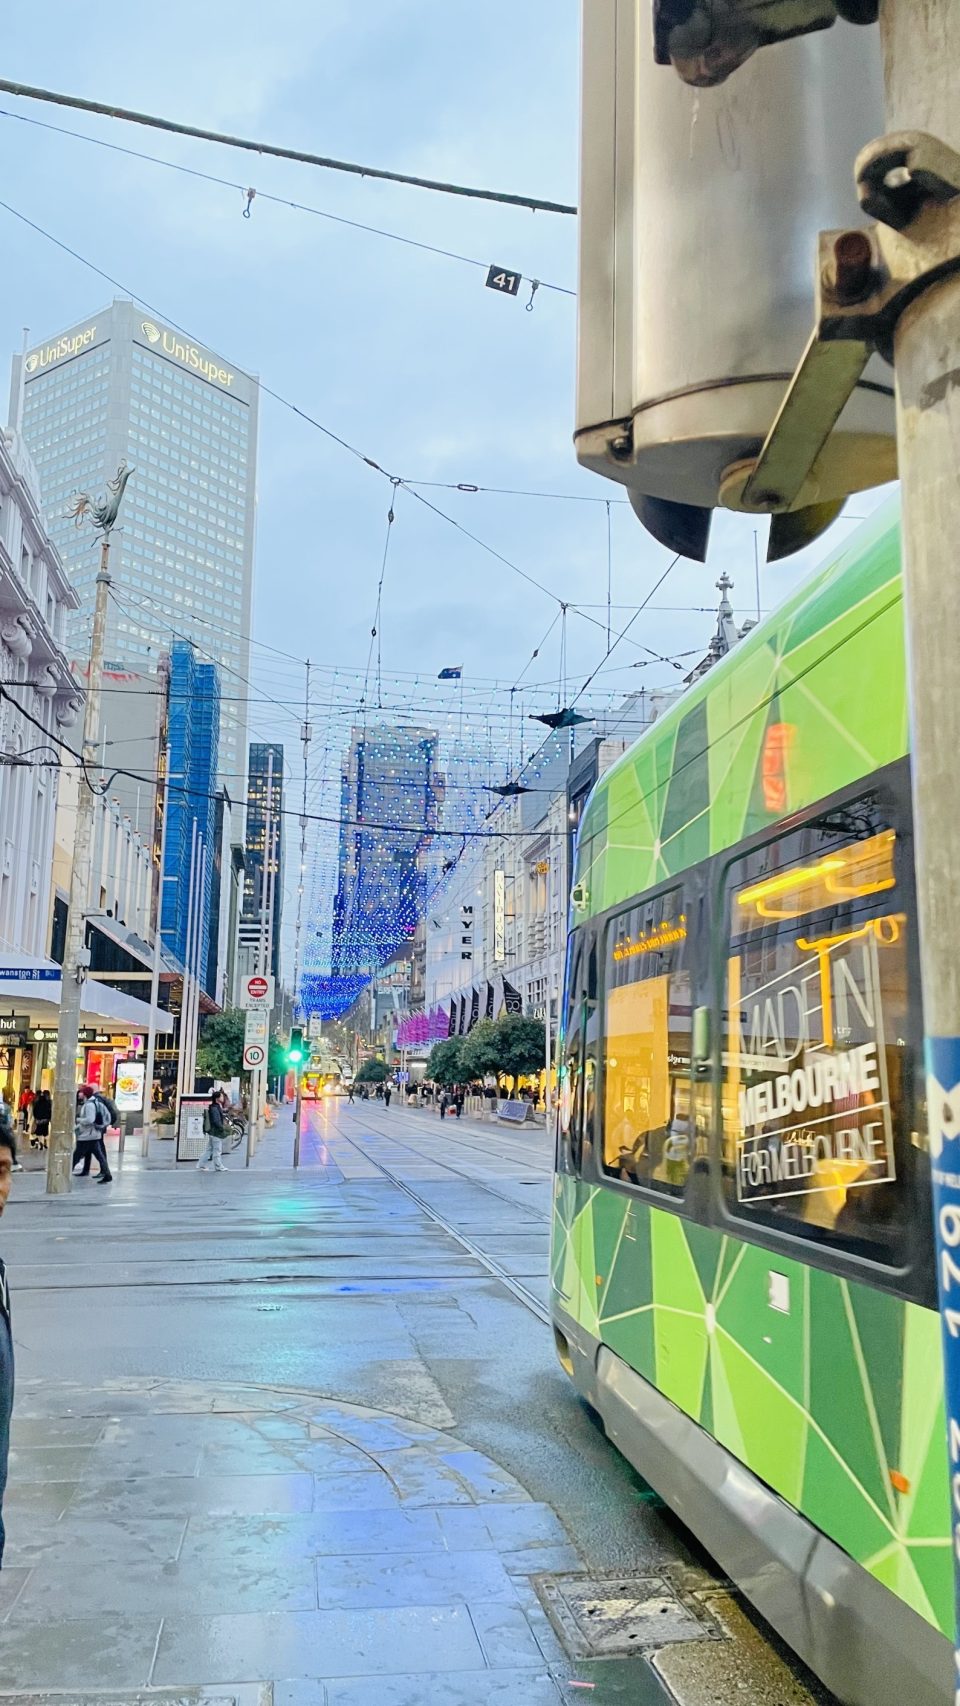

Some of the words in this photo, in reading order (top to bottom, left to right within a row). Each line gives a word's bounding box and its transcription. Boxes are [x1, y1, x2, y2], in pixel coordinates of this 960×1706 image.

[492, 272, 516, 291] 41
[40, 327, 96, 367] UniSuper
[163, 332, 234, 386] UniSuper
[461, 905, 473, 960] MYER
[0, 969, 31, 978] wanston
[32, 969, 40, 978] St
[0, 1019, 17, 1029] hut
[249, 1051, 260, 1060] 10
[739, 1041, 880, 1129] MELBOURNE
[740, 1149, 772, 1188] FOR
[770, 1121, 887, 1182] MELBOURNE
